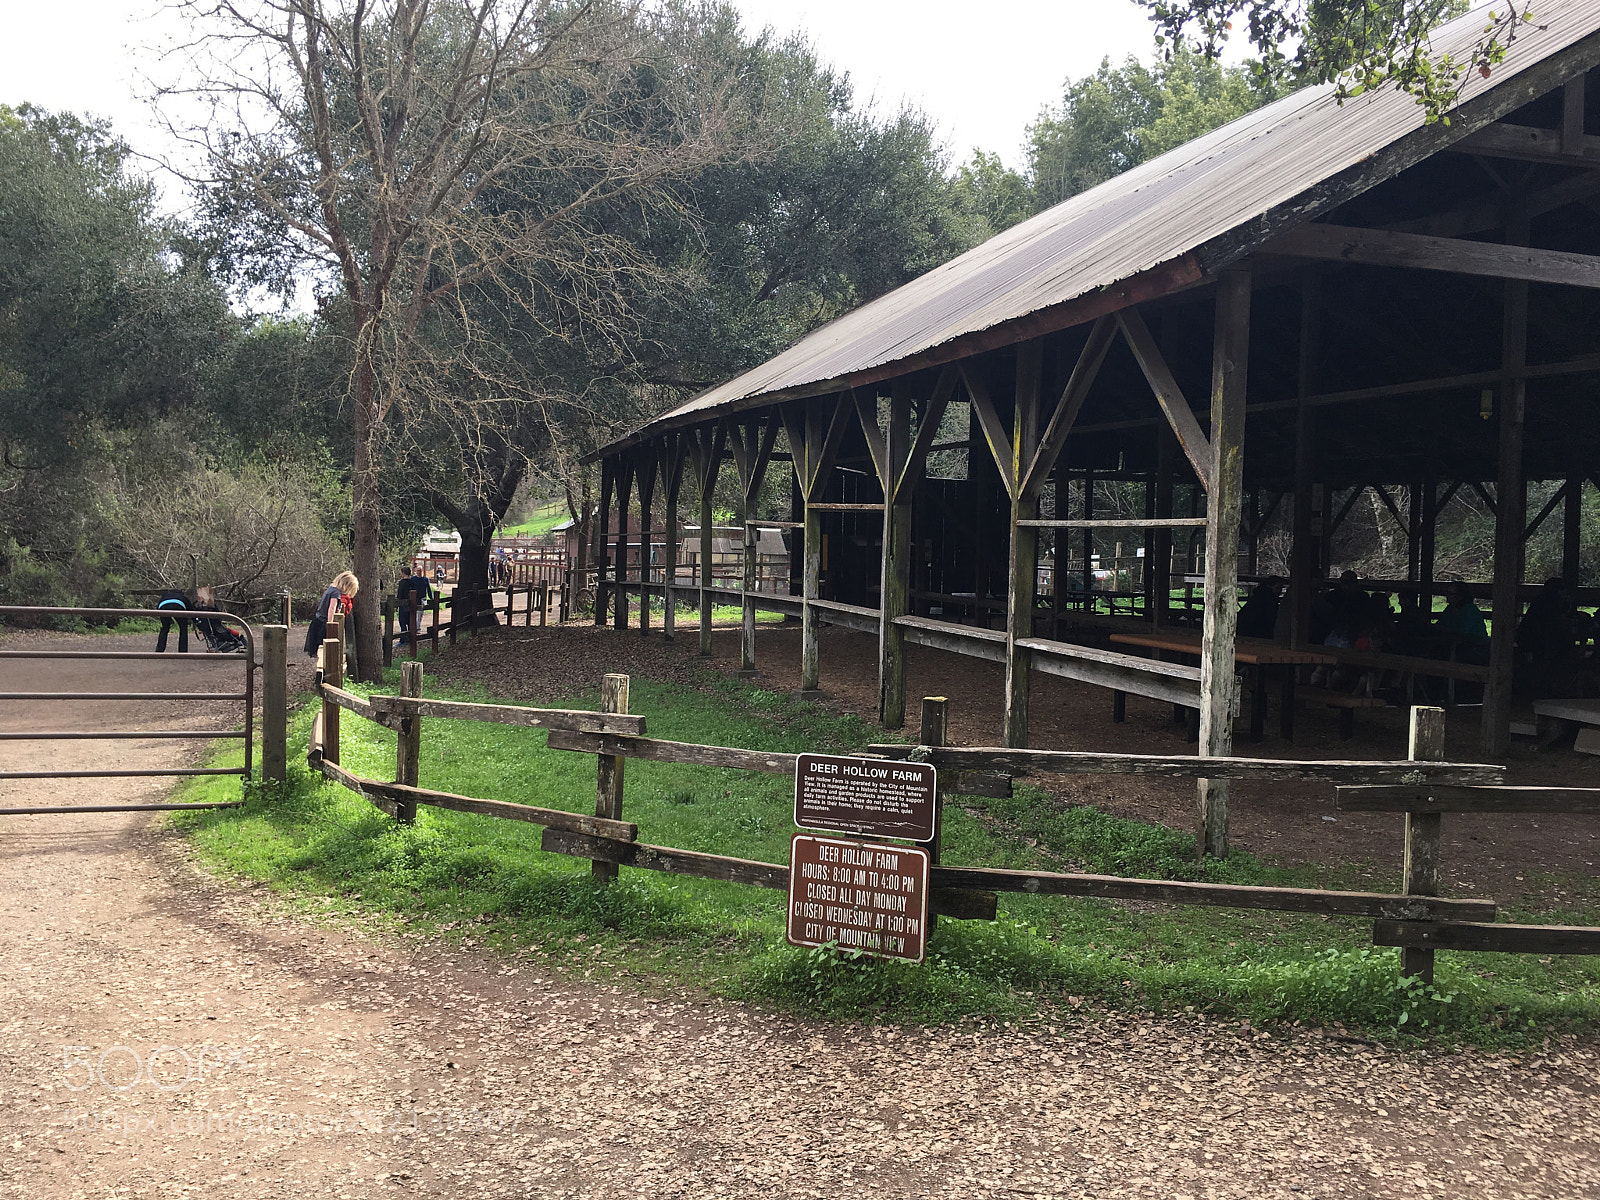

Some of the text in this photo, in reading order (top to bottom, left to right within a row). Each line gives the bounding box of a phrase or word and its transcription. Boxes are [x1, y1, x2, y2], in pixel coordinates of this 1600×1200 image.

[810, 762, 922, 782] DEER HOLLOW FARM
[820, 845, 898, 870] DEER HOLLOW FARM
[802, 863, 914, 893] HOURS: 8:00 AM TO 4:00 PM
[807, 883, 907, 912] CLOSED ALL DAY MONDAY
[795, 901, 919, 935] CLOSED WEDNESDAY AT 1:00 PM
[805, 923, 905, 953] CITY OF MOUNTAIN VIEW
